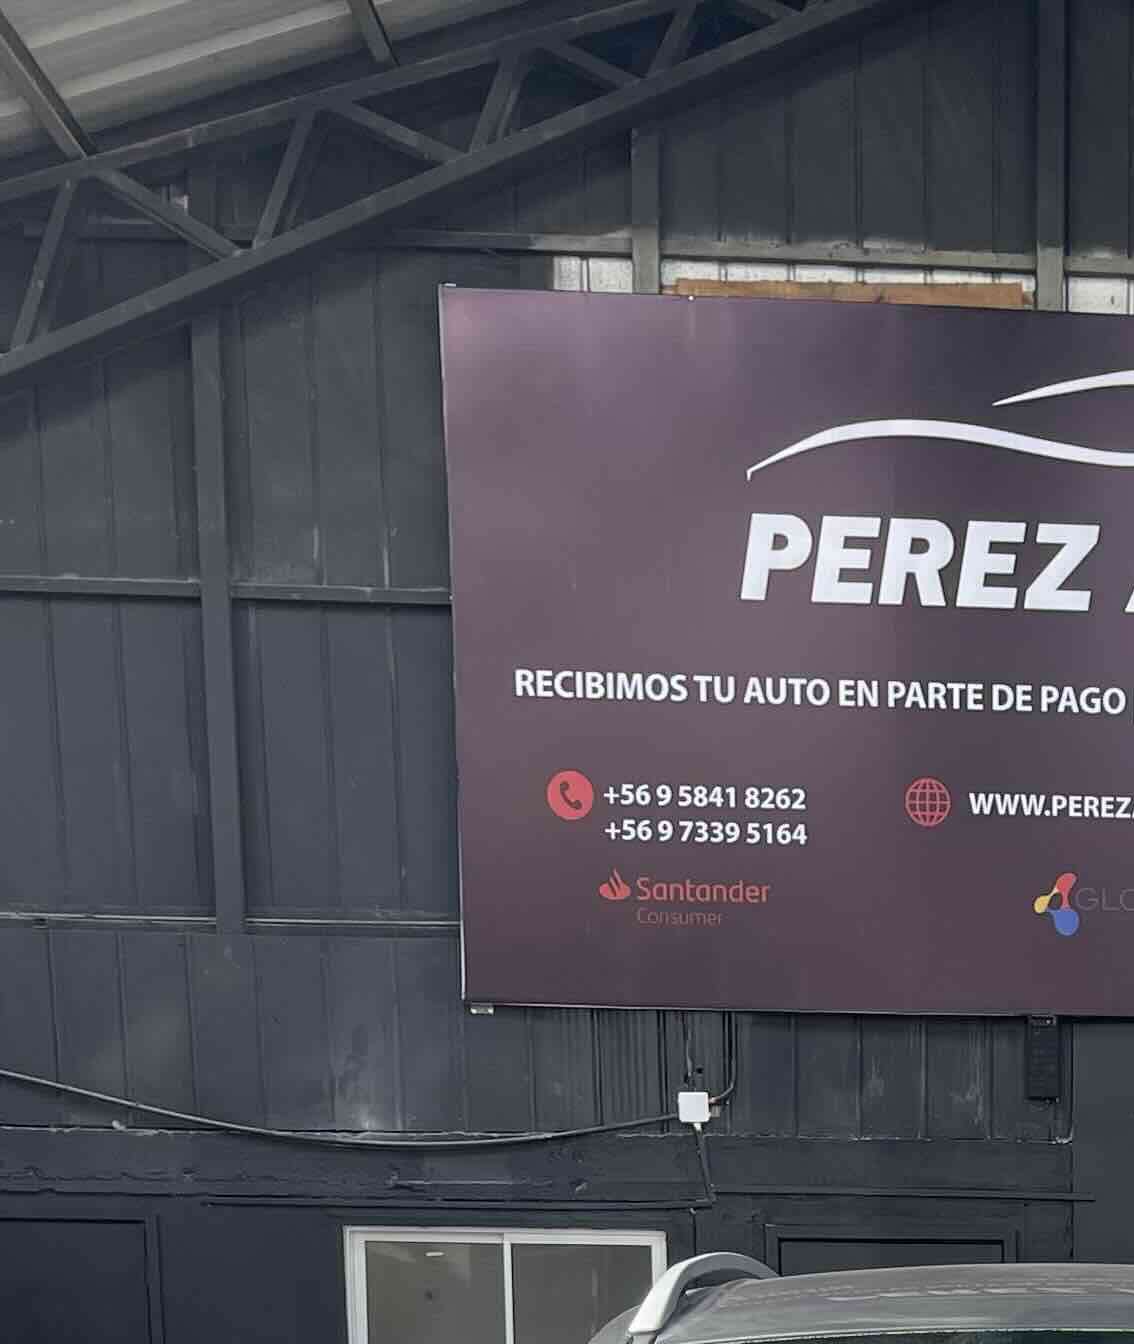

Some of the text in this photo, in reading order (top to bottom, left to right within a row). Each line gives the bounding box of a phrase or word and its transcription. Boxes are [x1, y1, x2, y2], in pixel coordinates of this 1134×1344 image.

[740, 512, 1100, 612] PEREZ
[514, 669, 688, 701] RECIBIMOS
[694, 675, 735, 703] TU
[743, 677, 830, 706] AUTO
[838, 680, 878, 707] EN
[887, 681, 983, 711] PARTE
[992, 685, 1032, 712] DE
[1040, 686, 1126, 714] PAGO
[603, 784, 806, 810] +56 9 5841 8262
[605, 820, 807, 845] +56 9 7339 5164
[636, 877, 769, 903] Santander
[637, 906, 722, 926] Consumer
